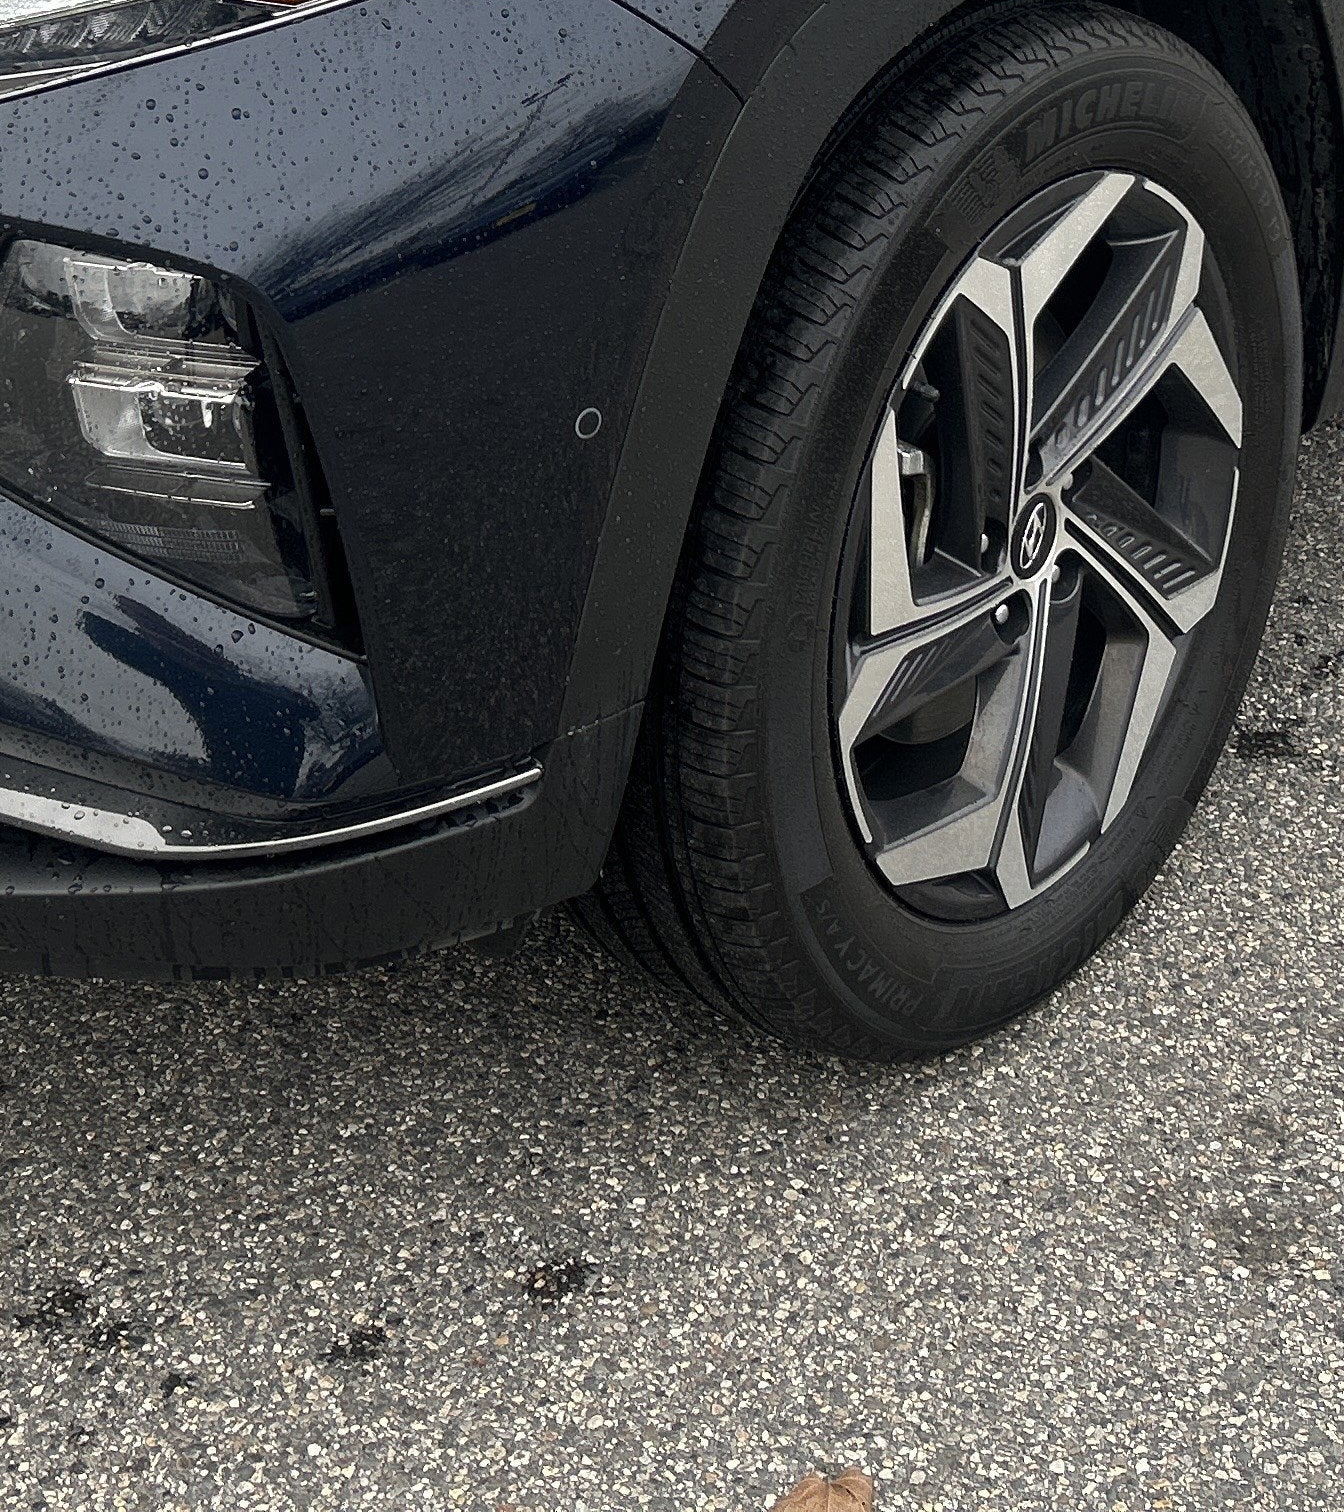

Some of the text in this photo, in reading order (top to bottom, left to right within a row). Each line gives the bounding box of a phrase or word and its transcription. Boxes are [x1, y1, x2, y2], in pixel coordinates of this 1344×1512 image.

[1023, 81, 1206, 160] MICHELIN
[816, 898, 924, 1017] PRIMACY A/S
